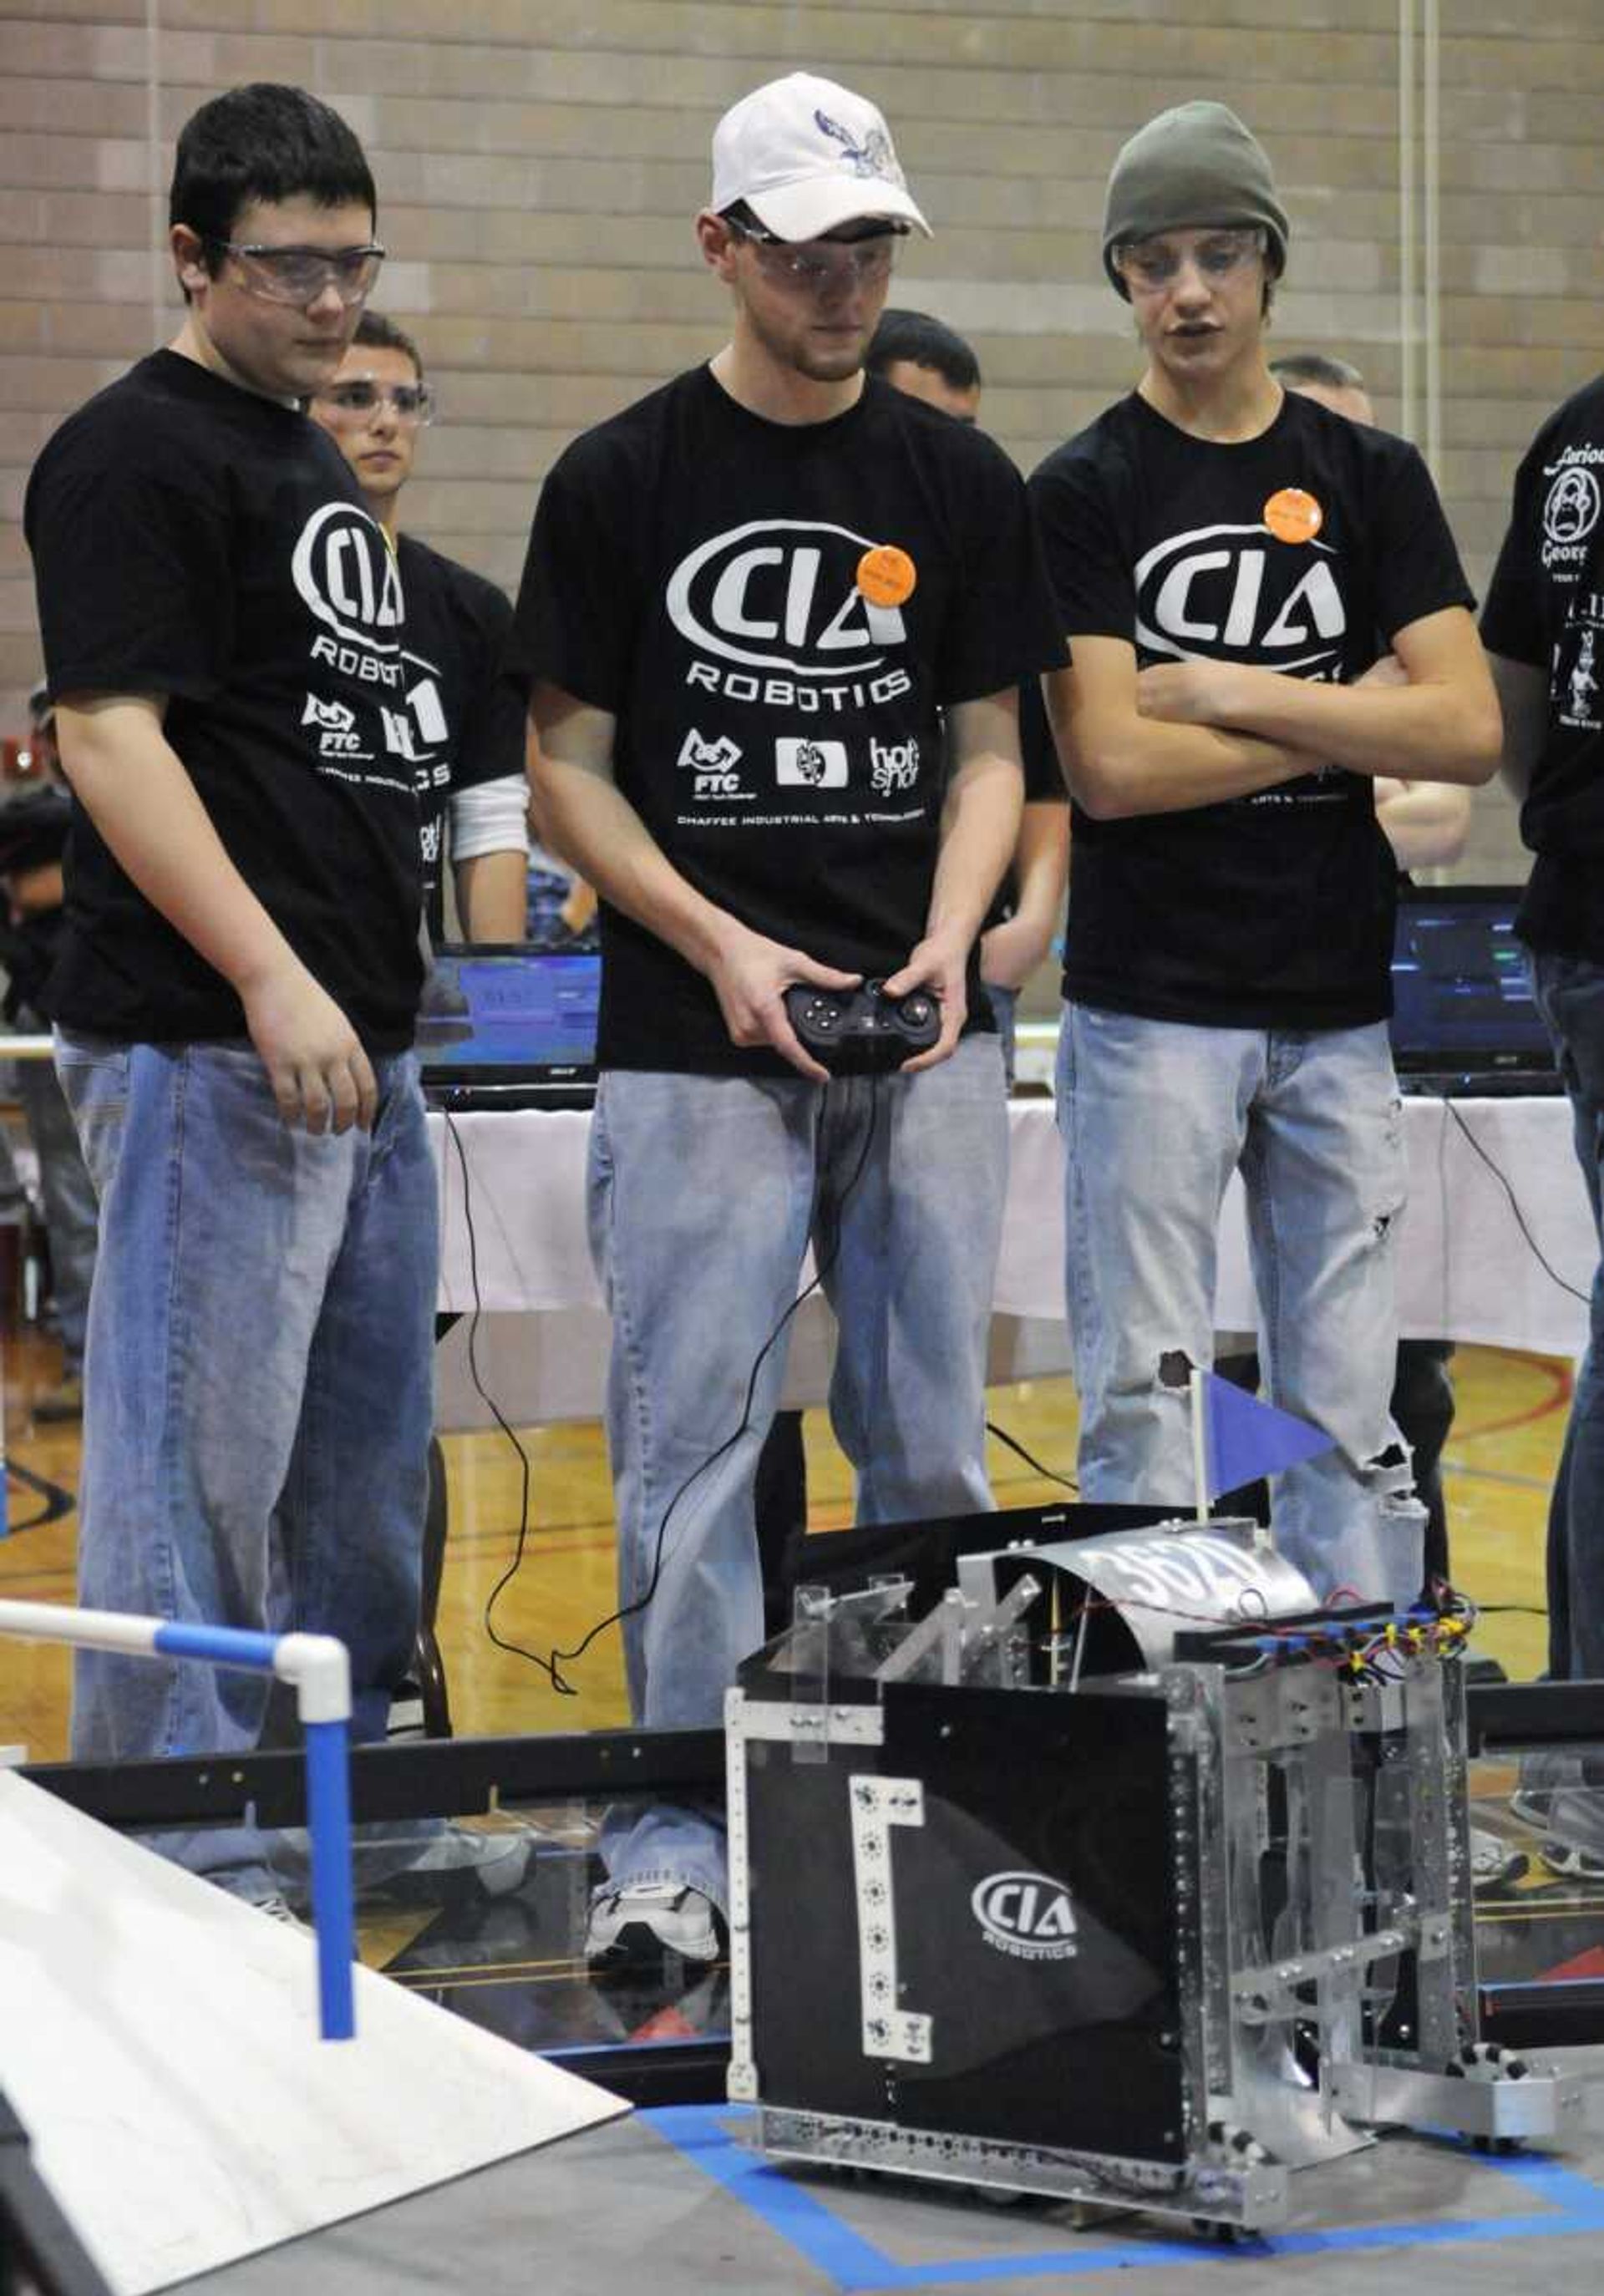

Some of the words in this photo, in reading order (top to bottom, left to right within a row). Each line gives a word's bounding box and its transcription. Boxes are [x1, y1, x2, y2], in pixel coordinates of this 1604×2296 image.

[711, 547, 907, 650] CIA
[1155, 550, 1346, 647] CIA
[686, 661, 912, 712] ROBOTICS
[319, 732, 361, 751] FTC
[694, 773, 740, 793] FTC
[742, 814, 820, 825] INDUSTRIAL
[1078, 1536, 1268, 1604] 3620
[988, 1883, 1077, 1936] CIA
